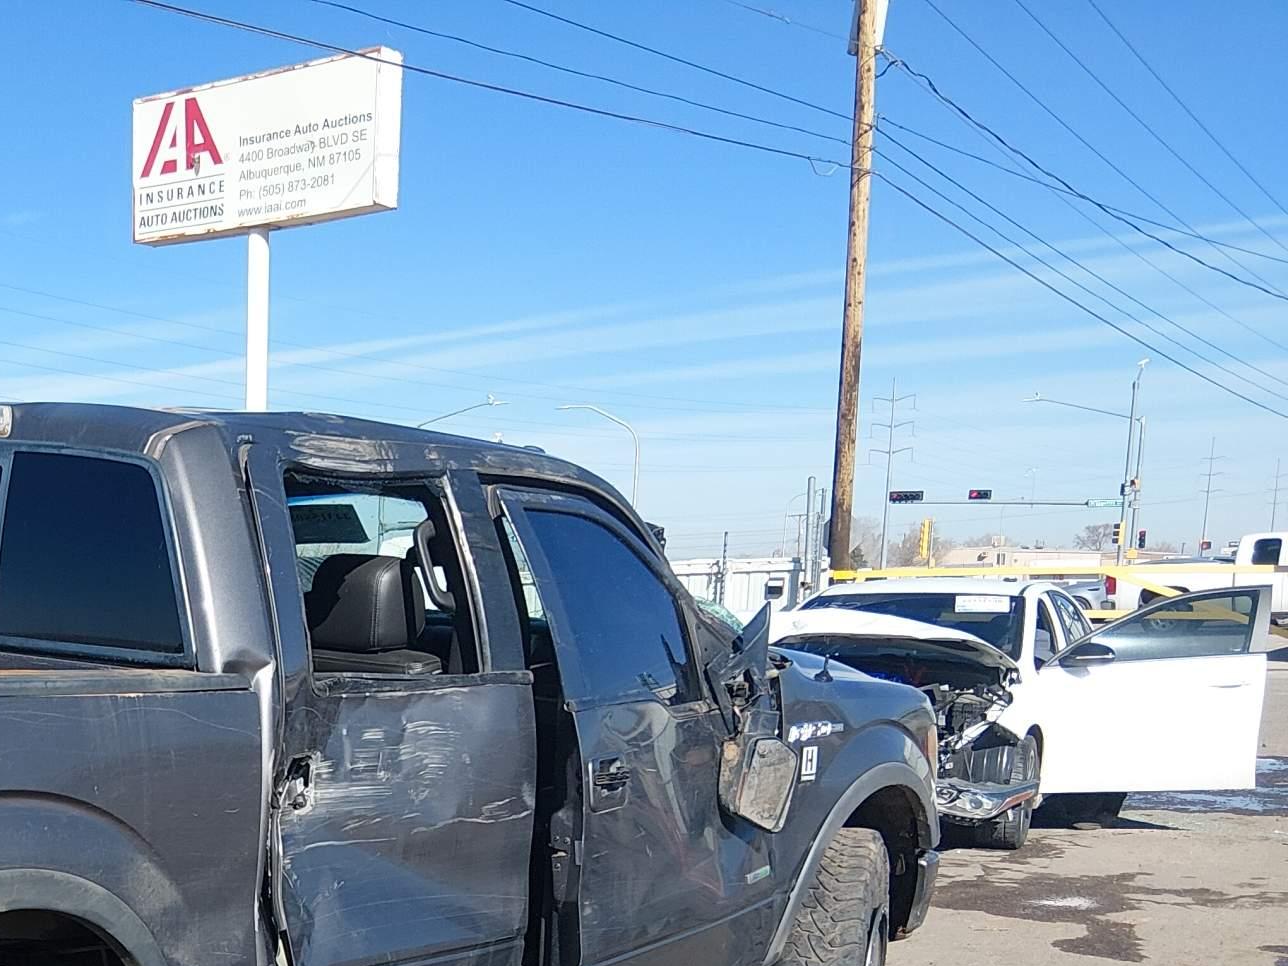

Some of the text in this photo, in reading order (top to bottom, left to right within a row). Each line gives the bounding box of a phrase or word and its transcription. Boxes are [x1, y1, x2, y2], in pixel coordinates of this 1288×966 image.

[239, 112, 373, 148] Insurance Auto Auctions
[239, 128, 368, 164] 4400 Broadway BLVD SE
[239, 148, 361, 181] Albuquerque, NM 87105
[140, 180, 224, 206] INSURANCE
[258, 183, 285, 199] (505)
[287, 174, 334, 192] 873-2081
[139, 203, 224, 228] AUTO AUCTIONS
[237, 198, 306, 217] www.iaai.com
